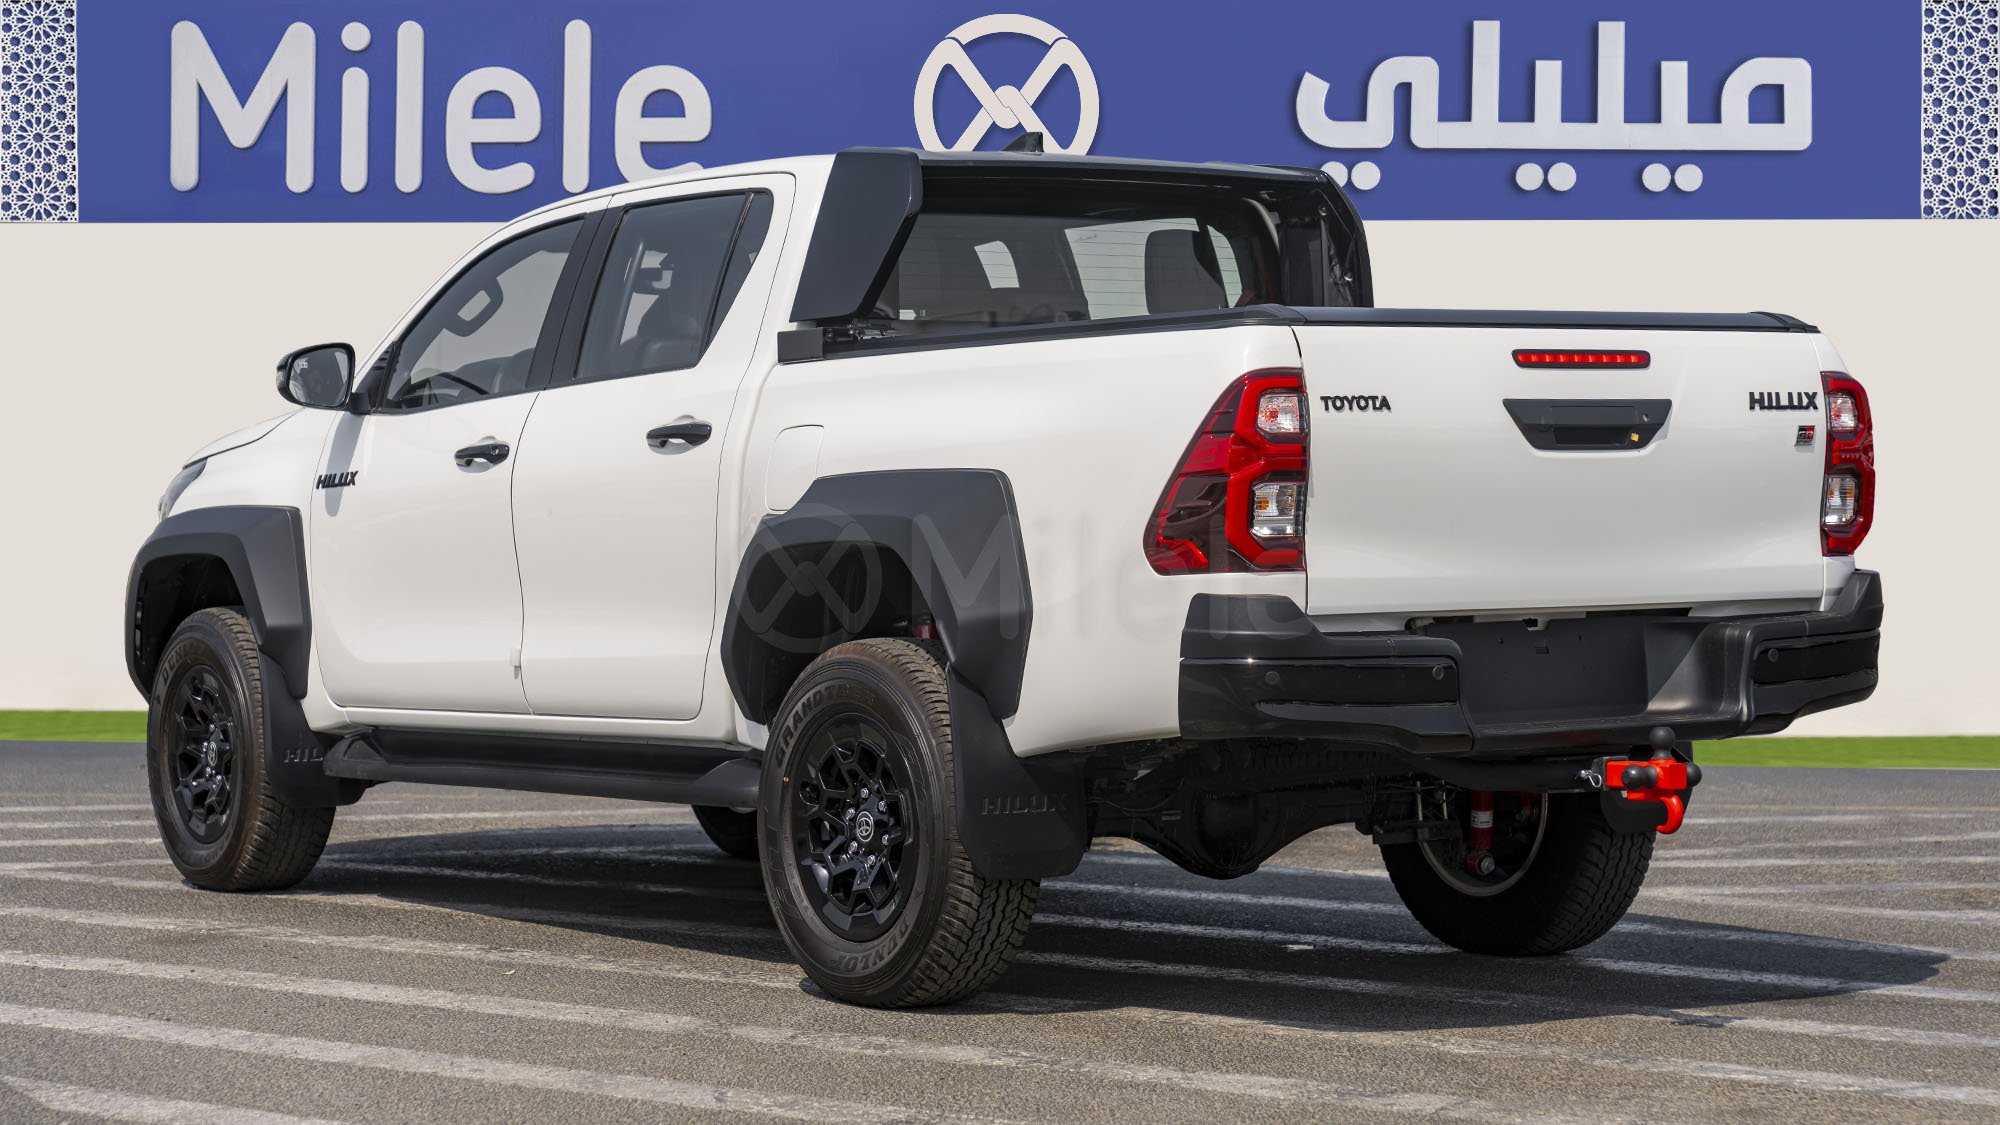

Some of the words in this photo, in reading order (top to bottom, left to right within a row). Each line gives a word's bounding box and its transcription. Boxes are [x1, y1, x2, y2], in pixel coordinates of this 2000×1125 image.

[169, 19, 712, 194] Milele
[1296, 20, 1813, 192] ميليلي
[1320, 395, 1392, 411] TOYOTA
[1749, 391, 1818, 411] HILUX
[315, 471, 359, 489] HILUX
[284, 748, 324, 763] HIL
[980, 793, 1068, 816] HILUX
